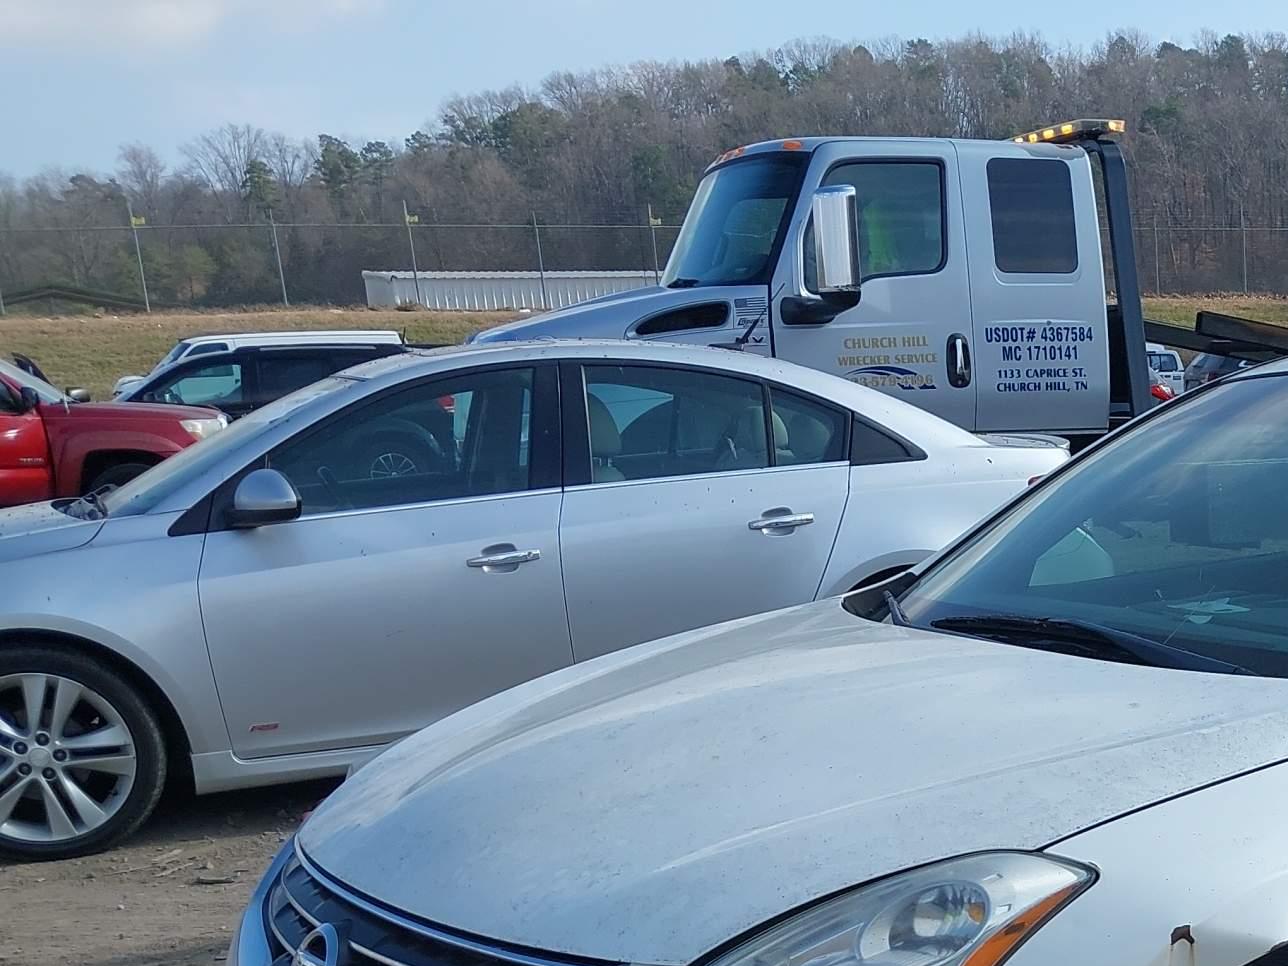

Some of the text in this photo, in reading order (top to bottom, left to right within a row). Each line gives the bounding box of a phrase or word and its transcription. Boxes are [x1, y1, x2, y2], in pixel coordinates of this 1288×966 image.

[985, 327, 1093, 342] USDOT# 4367584
[843, 335, 928, 349] CHURCH HILL
[838, 352, 938, 366] WRECKER SERVICE
[1002, 345, 1078, 361] MC 1710141
[998, 368, 1087, 378] 1133 CAPRICE ST.
[997, 381, 1088, 392] CHURCH HILL, TN
